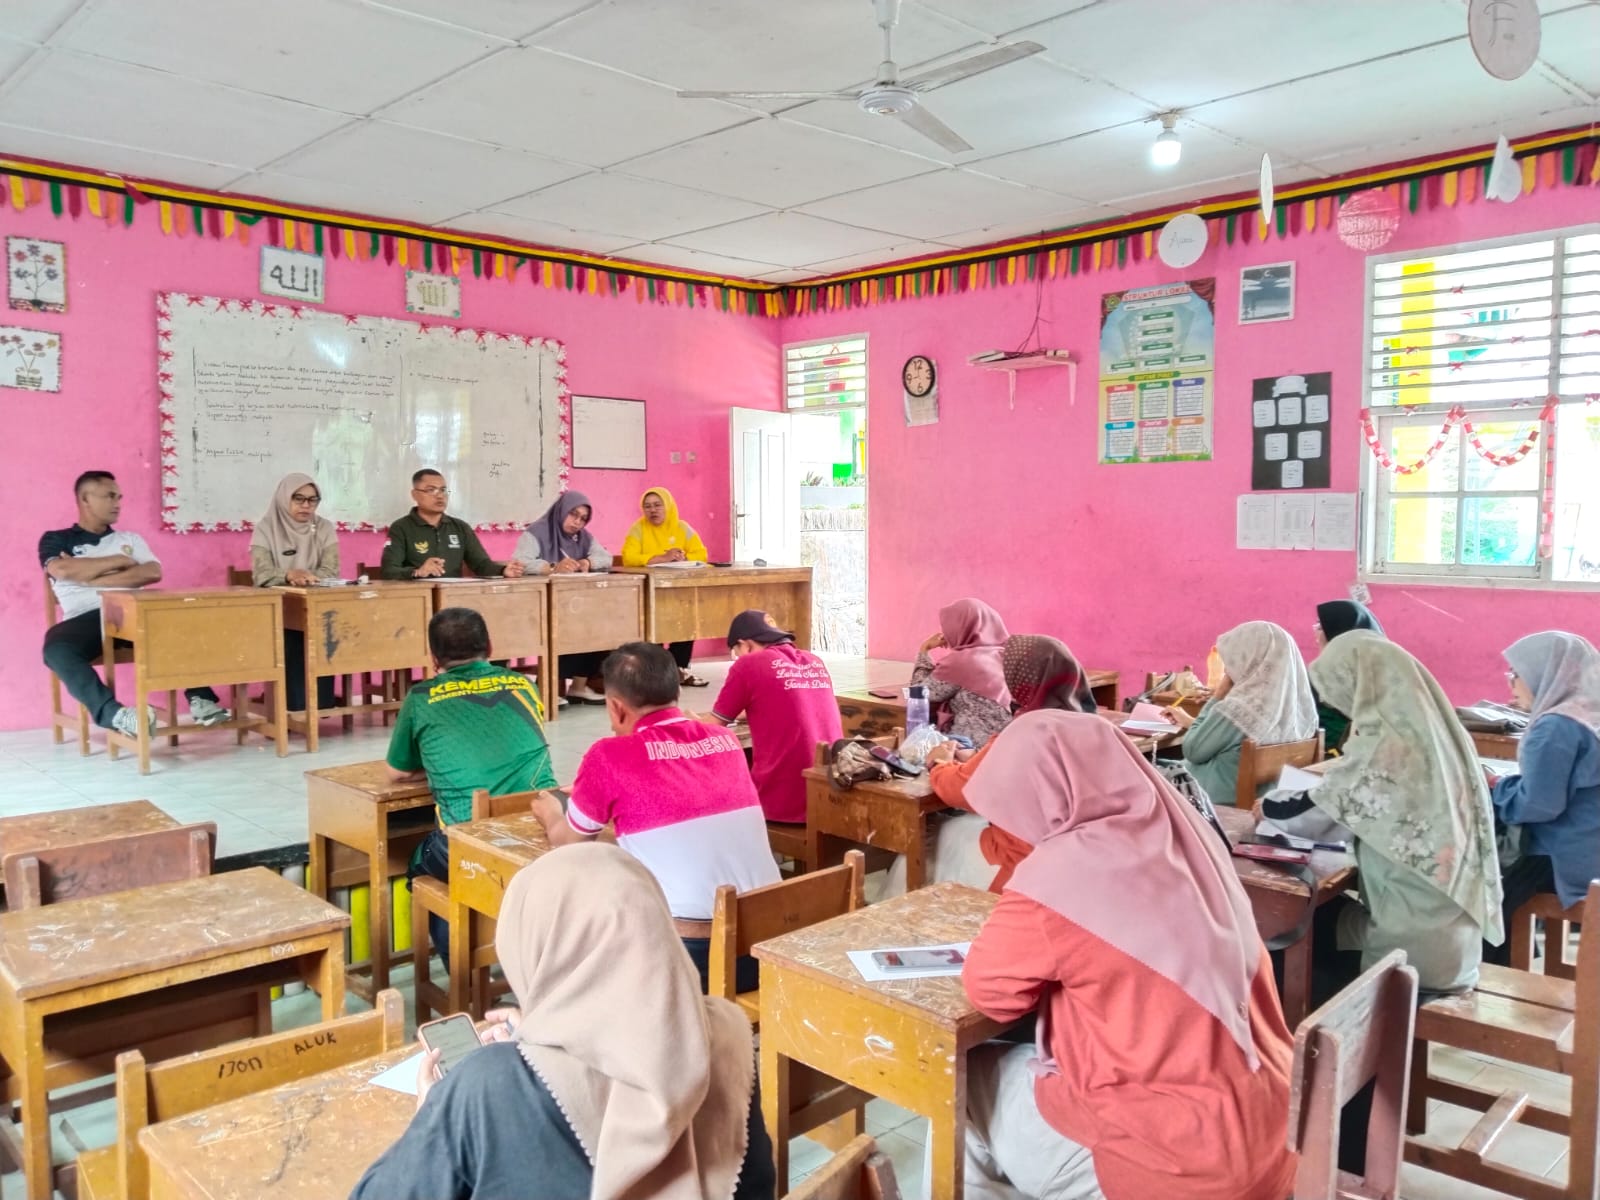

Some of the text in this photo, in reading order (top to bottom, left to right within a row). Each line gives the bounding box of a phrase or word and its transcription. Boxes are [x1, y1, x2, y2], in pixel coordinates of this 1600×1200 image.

[270, 265, 318, 297] الله
[645, 735, 740, 760] INDONESIA
[294, 1032, 337, 1055] ALUK
